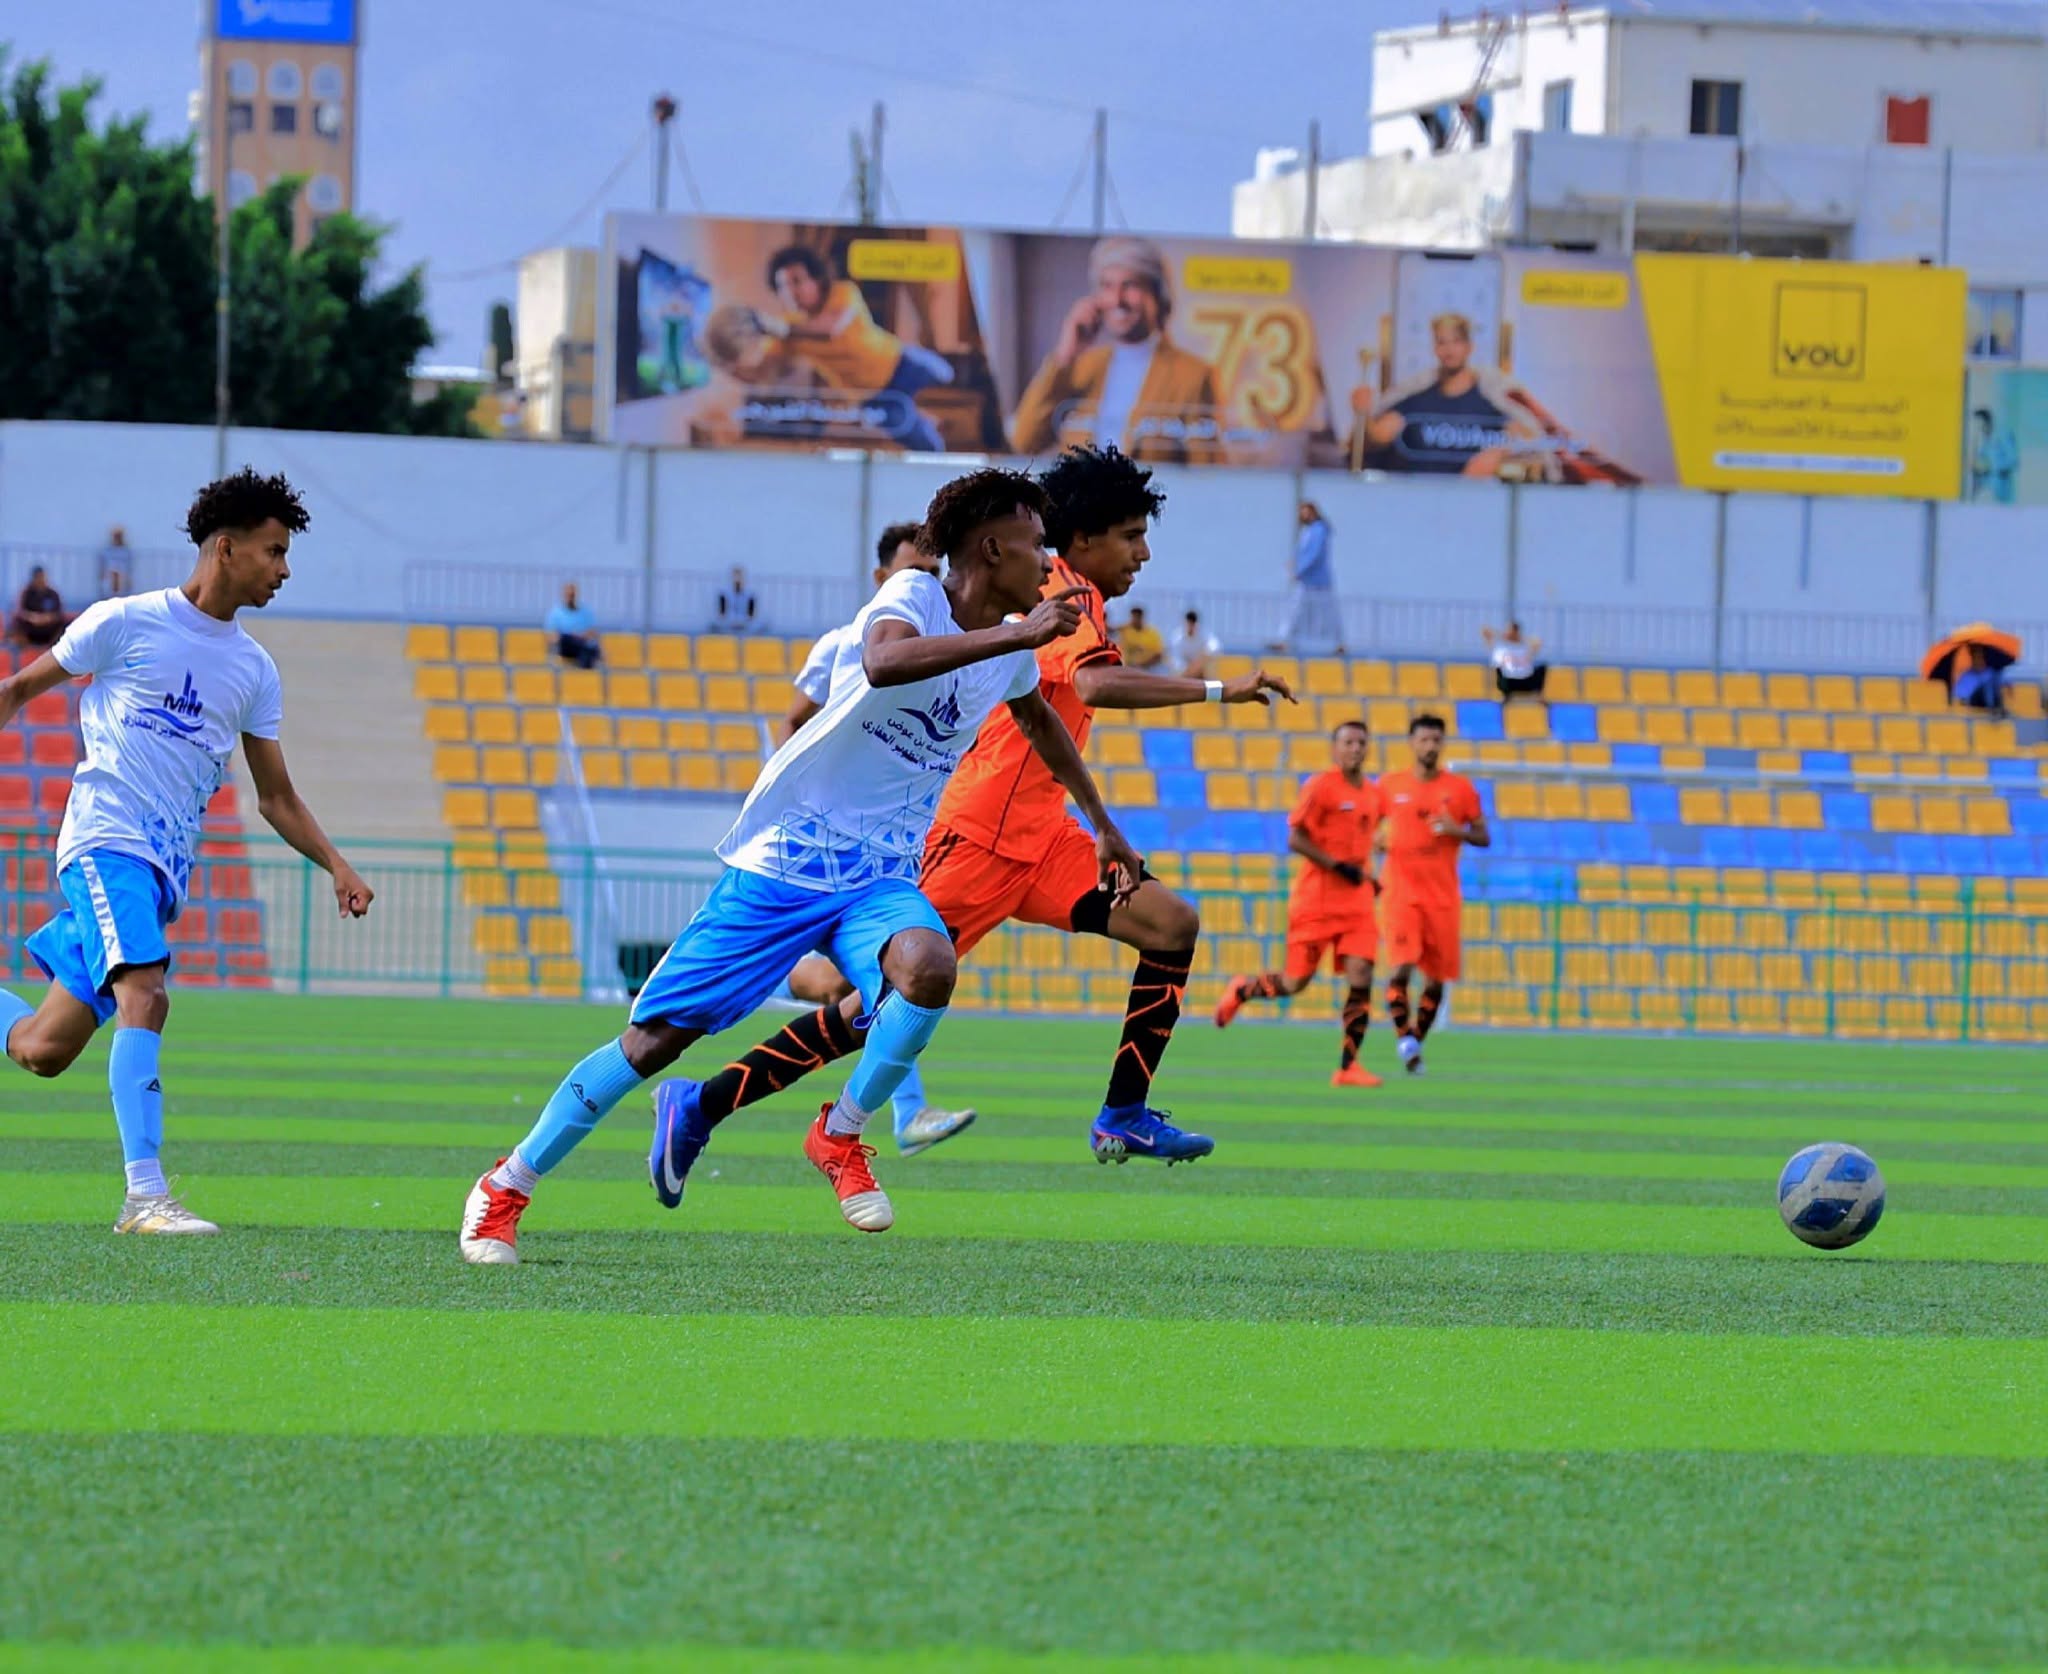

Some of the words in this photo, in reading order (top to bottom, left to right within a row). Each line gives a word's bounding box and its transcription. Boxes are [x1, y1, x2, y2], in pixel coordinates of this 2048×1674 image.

[1189, 303, 1313, 430] 73
[1782, 342, 1856, 368] YOU
[887, 719, 914, 739] عوض
[913, 738, 925, 748] بن
